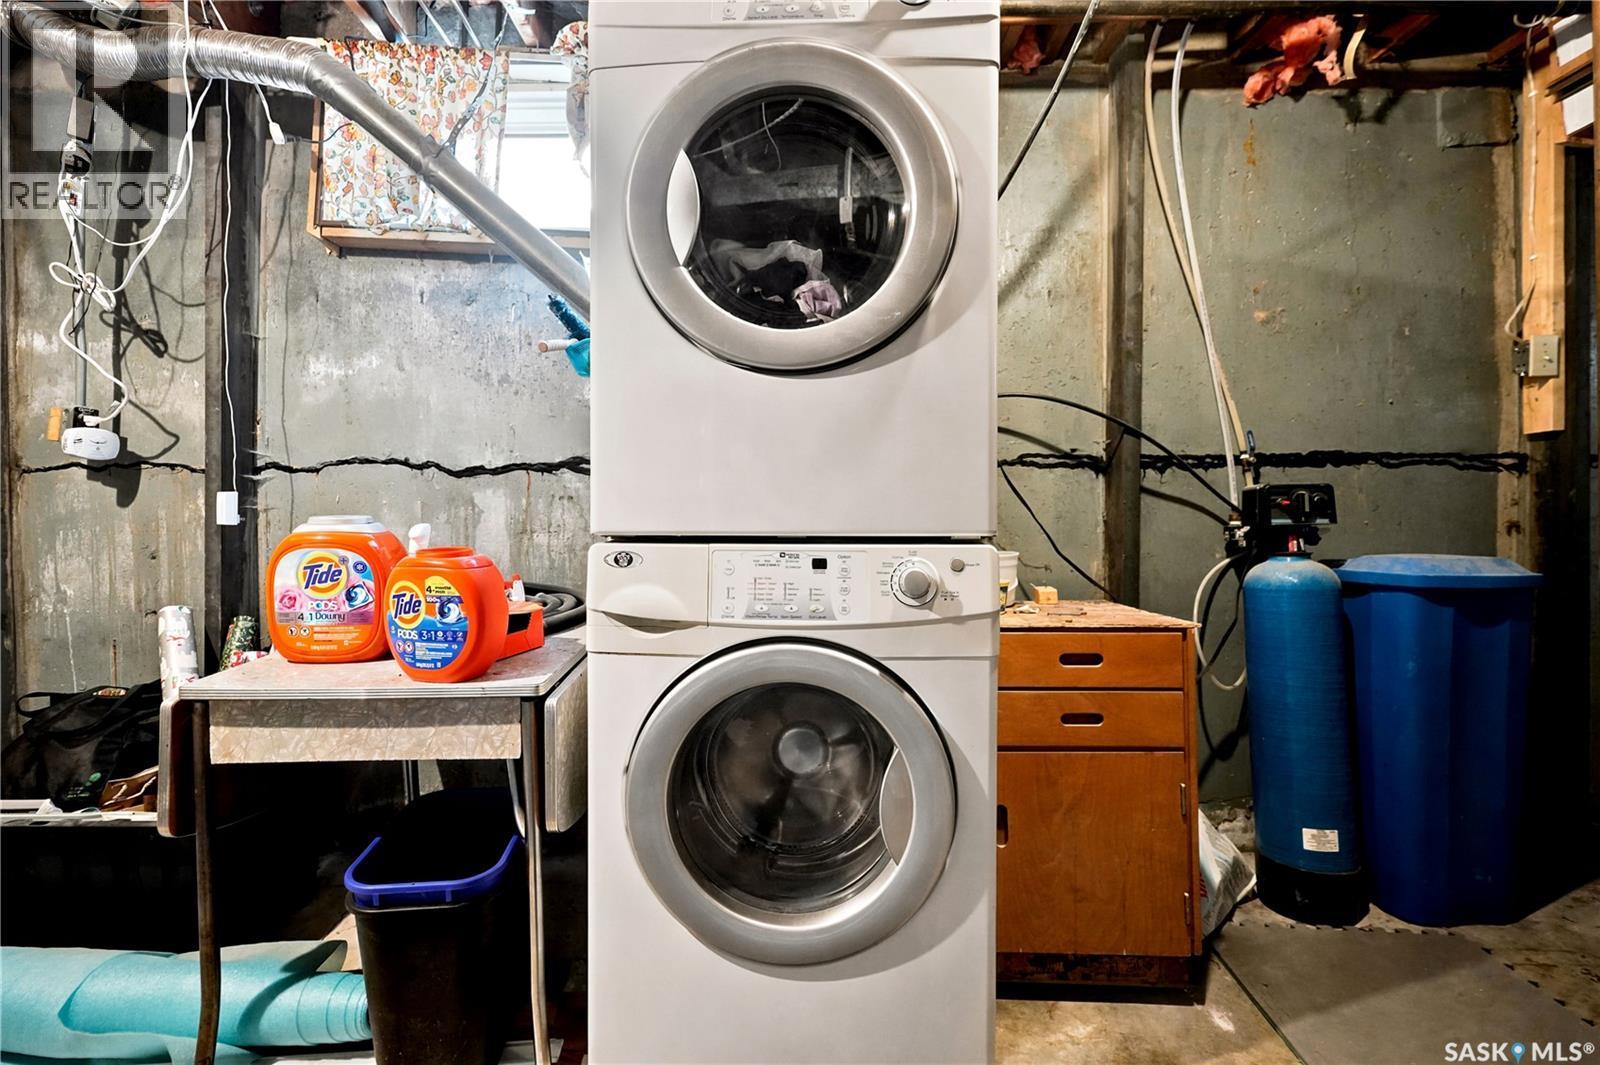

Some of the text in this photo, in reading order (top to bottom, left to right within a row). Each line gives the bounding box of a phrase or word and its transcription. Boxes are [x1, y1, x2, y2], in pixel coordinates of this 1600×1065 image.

[303, 563, 343, 589] Tide
[392, 592, 422, 619] Tide
[314, 611, 345, 622] Downy
[397, 629, 418, 640] PODS
